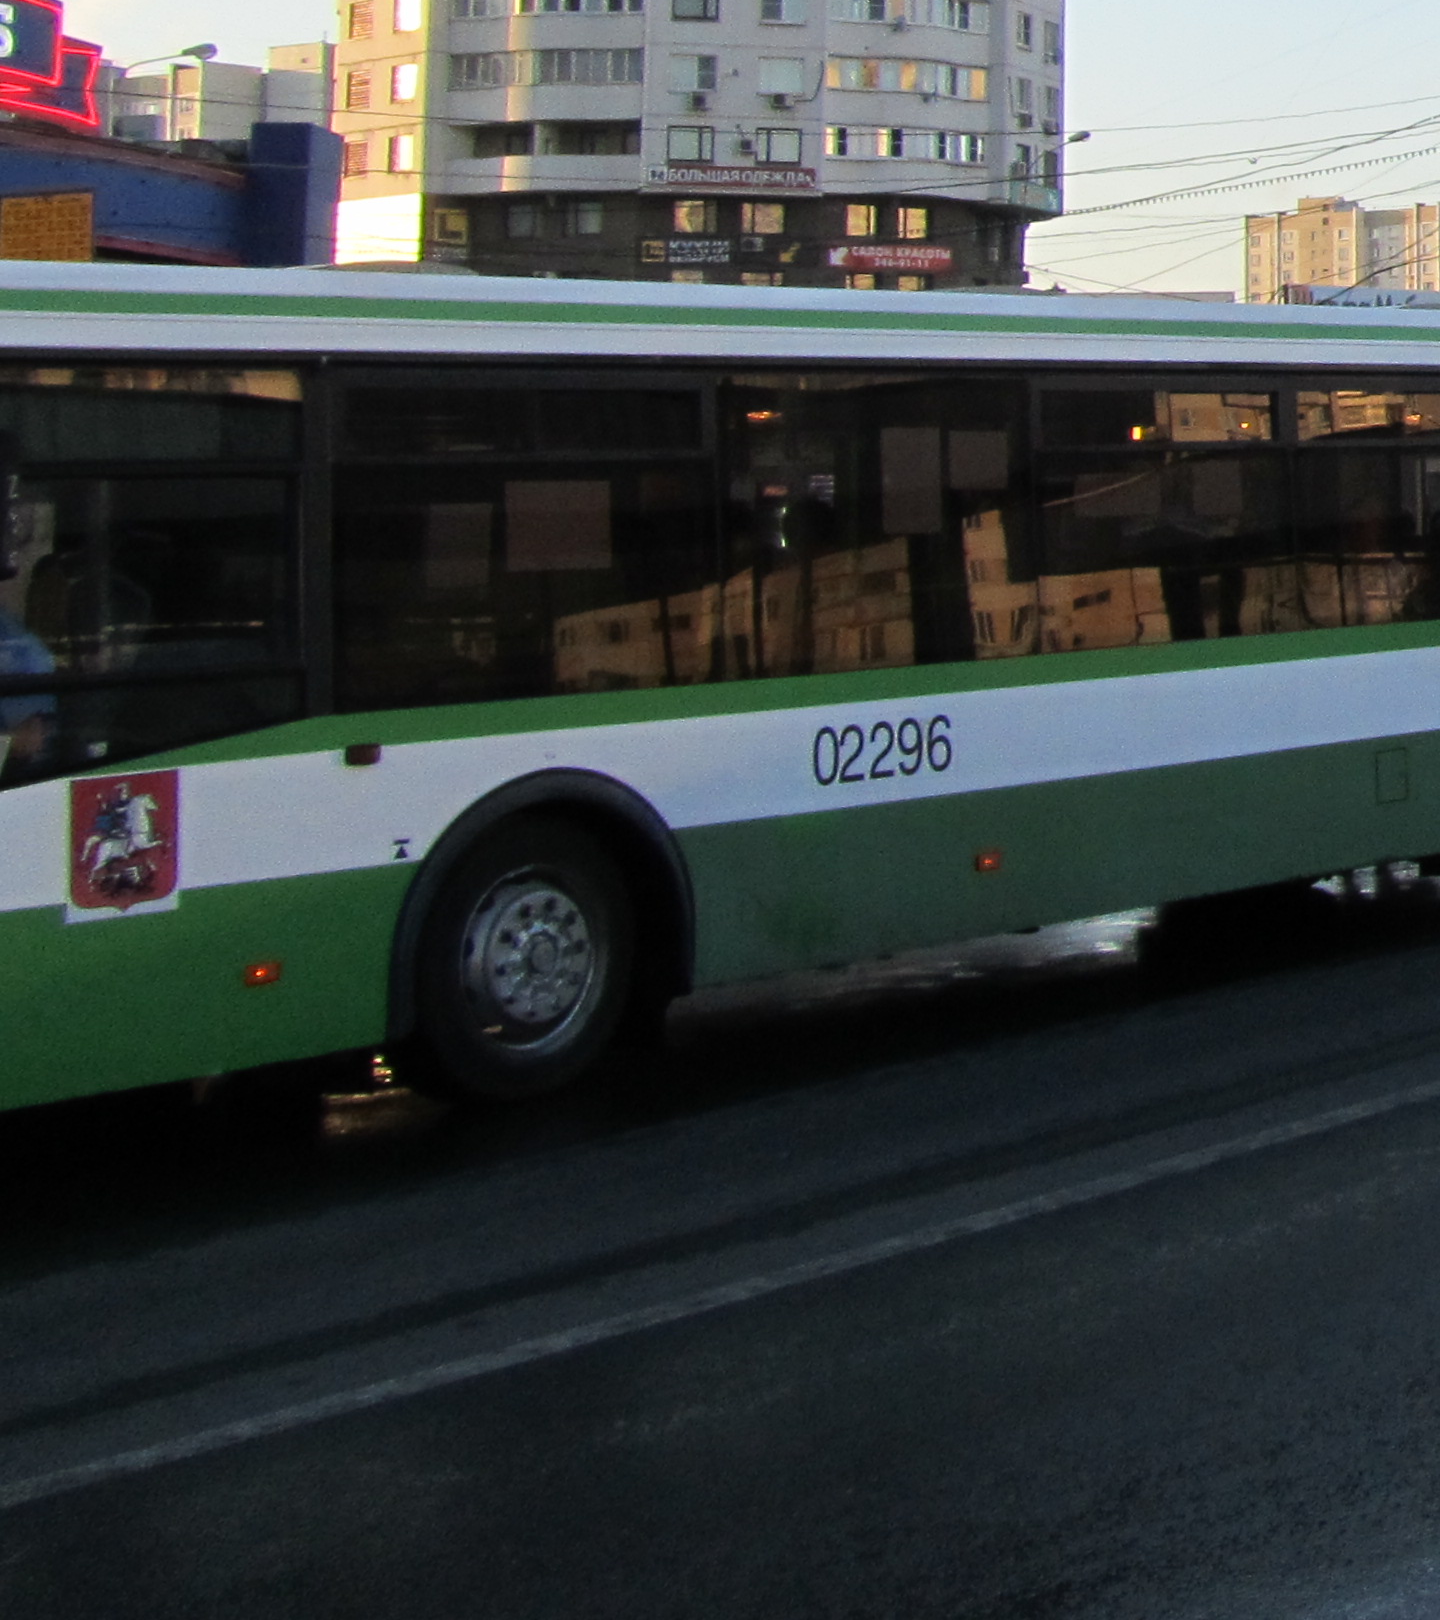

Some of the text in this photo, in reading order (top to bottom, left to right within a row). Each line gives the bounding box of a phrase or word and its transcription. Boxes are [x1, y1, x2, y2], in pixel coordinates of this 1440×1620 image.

[667, 168, 741, 183] БОЛЬШАЯ
[742, 170, 806, 185] ОДЕЖДА
[813, 714, 952, 786] 02296
